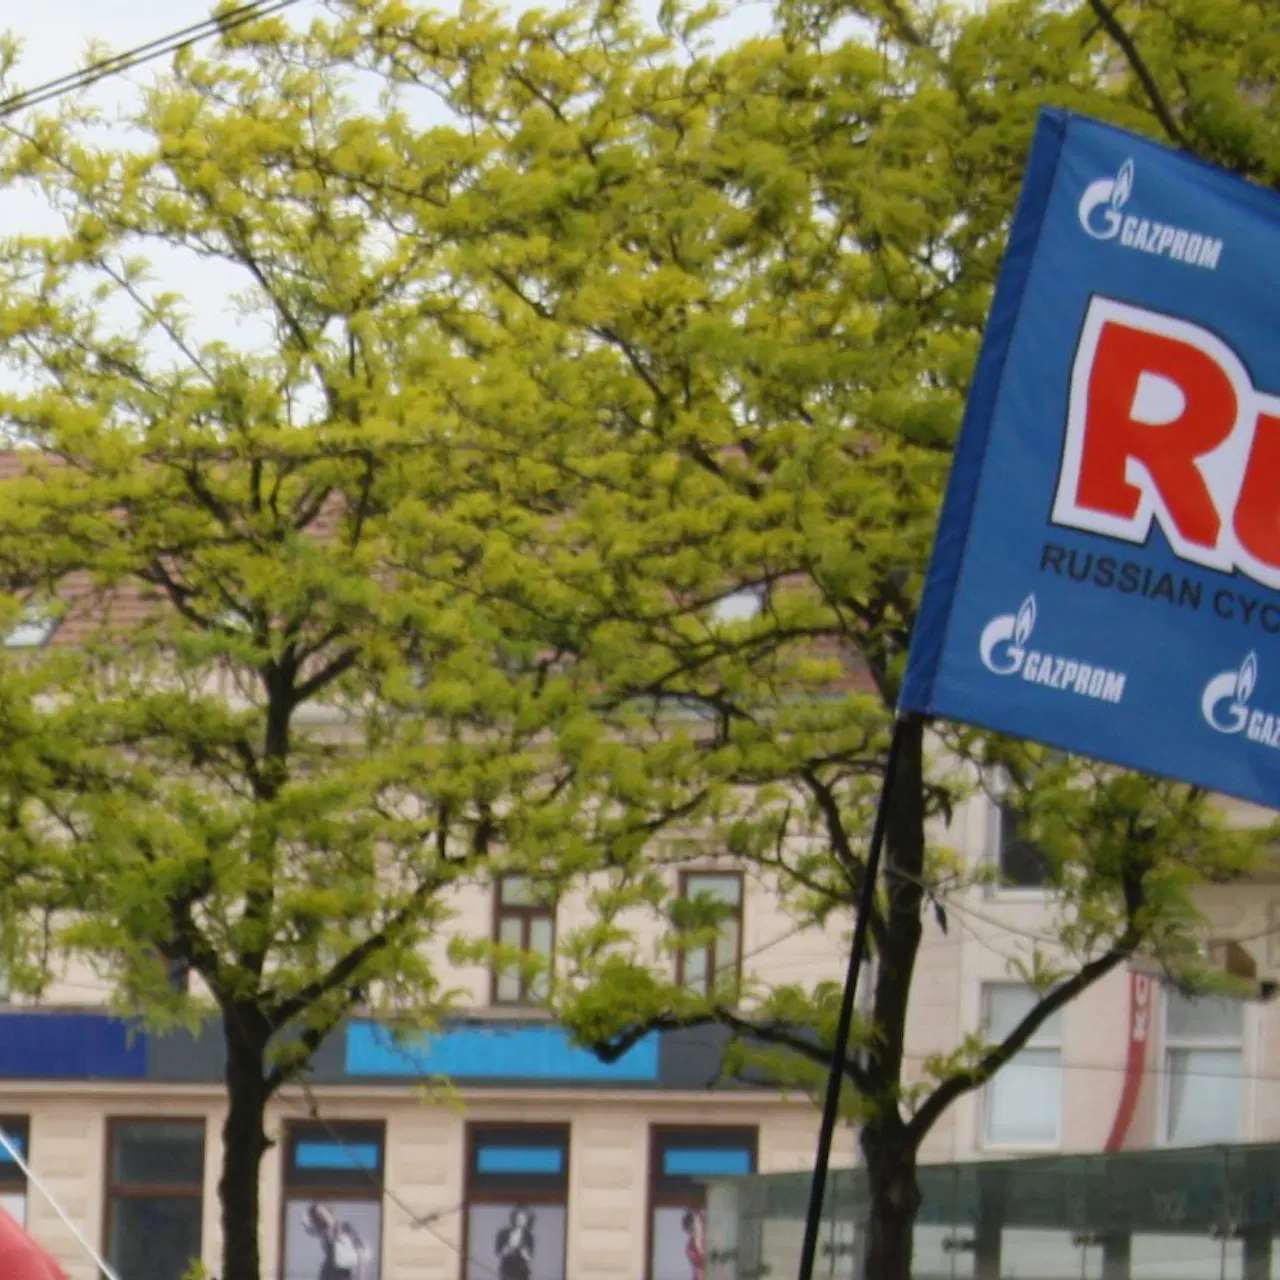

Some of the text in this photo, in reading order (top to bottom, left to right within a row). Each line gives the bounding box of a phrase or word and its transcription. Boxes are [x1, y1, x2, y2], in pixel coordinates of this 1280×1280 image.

[1119, 217, 1224, 270] GAZPROM
[1040, 540, 1204, 612] RUSSIAN
[1022, 650, 1128, 704] GAZPROM
